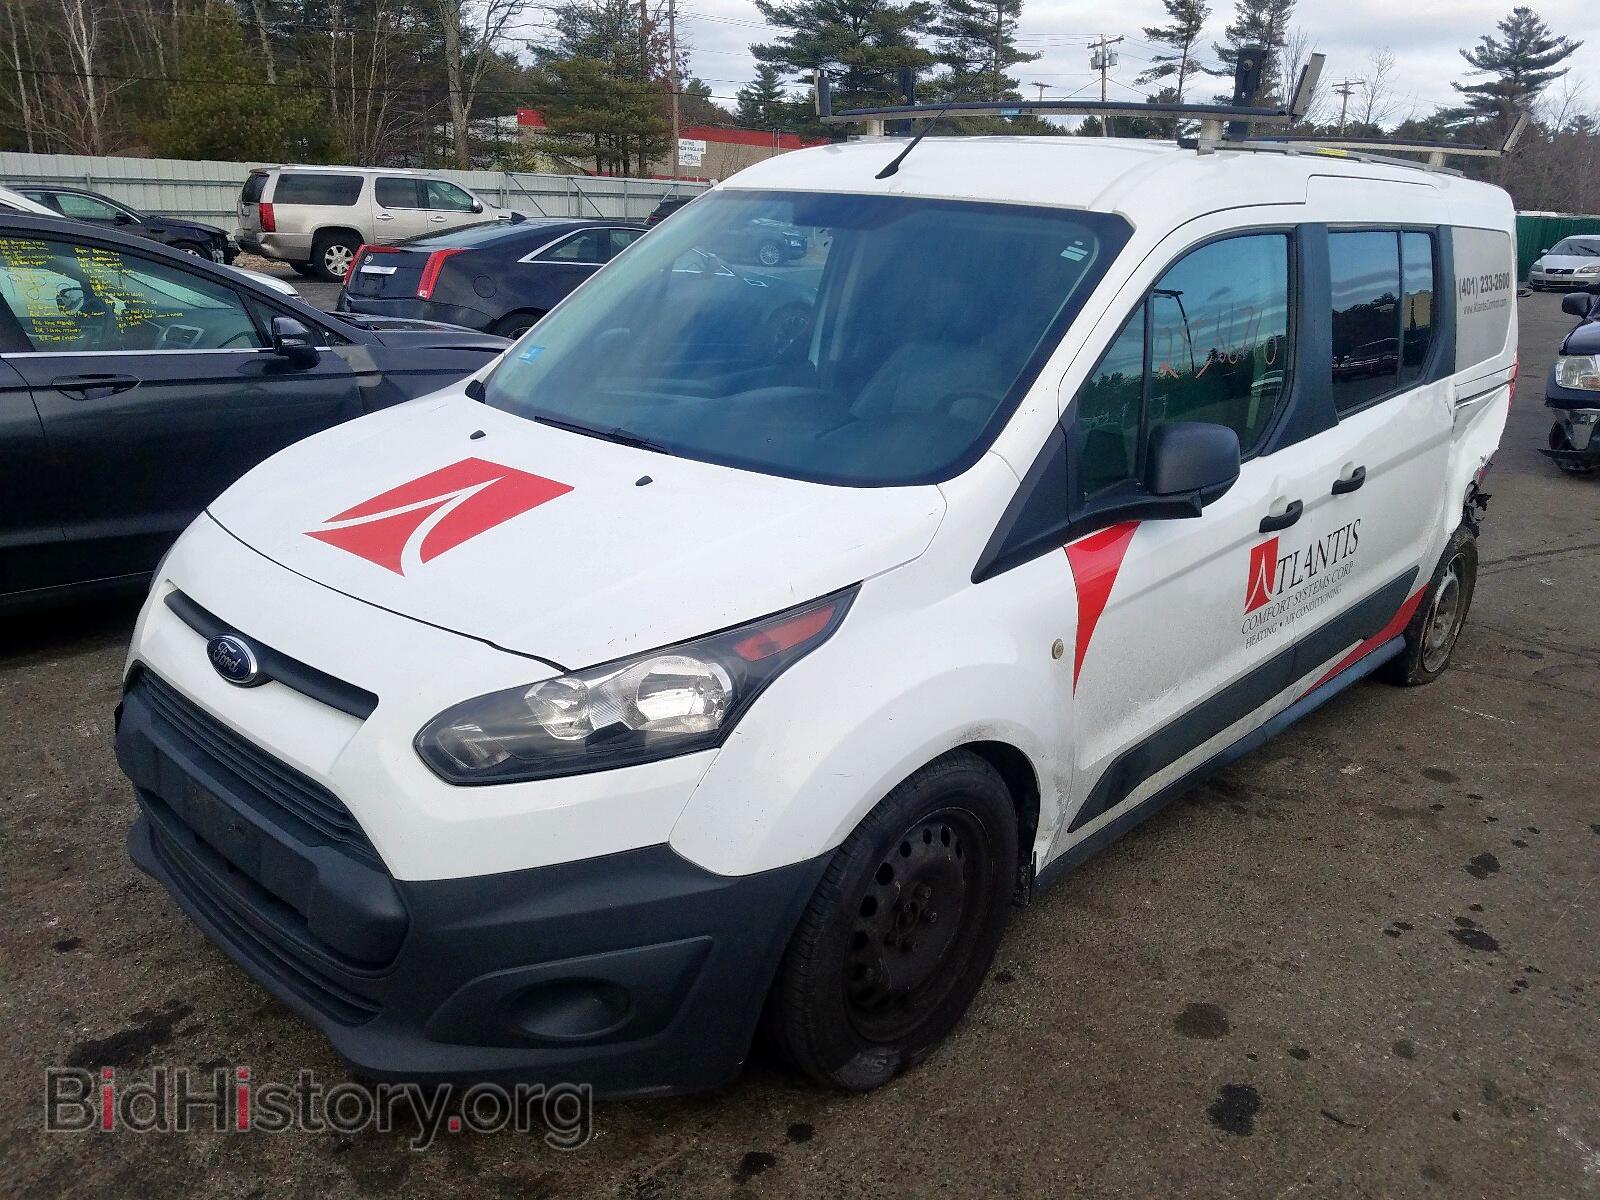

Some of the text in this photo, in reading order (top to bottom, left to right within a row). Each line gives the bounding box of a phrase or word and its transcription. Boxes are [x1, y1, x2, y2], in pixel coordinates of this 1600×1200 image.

[1459, 276, 1478, 300] (401)
[1241, 595, 1294, 635] COMFORT
[1293, 573, 1331, 606] SYSTEMS
[1245, 622, 1279, 649] HEATING
[1295, 585, 1343, 619] CONDITIONING
[213, 641, 242, 673] Ford
